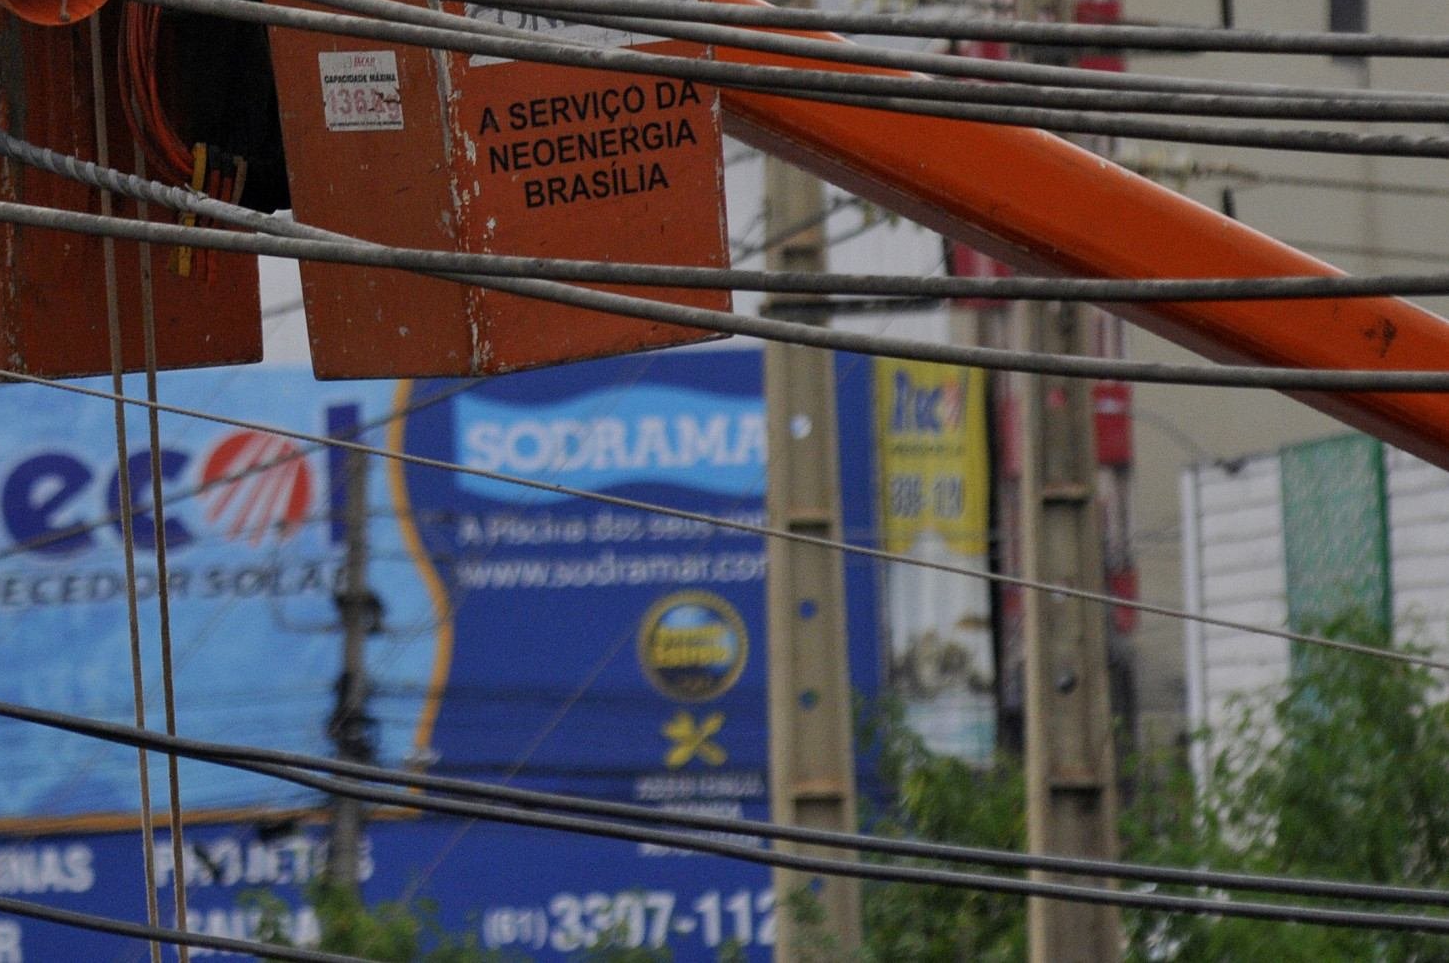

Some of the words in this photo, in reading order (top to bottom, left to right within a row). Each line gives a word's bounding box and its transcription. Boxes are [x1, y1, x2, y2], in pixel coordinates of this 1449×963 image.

[324, 74, 367, 84] CAPACIDADE
[479, 106, 501, 135] A
[508, 84, 645, 131] SERVIÇO
[655, 79, 701, 110] DA
[488, 118, 698, 174] NEOENERGIA
[524, 160, 670, 209] BRASÍLIA
